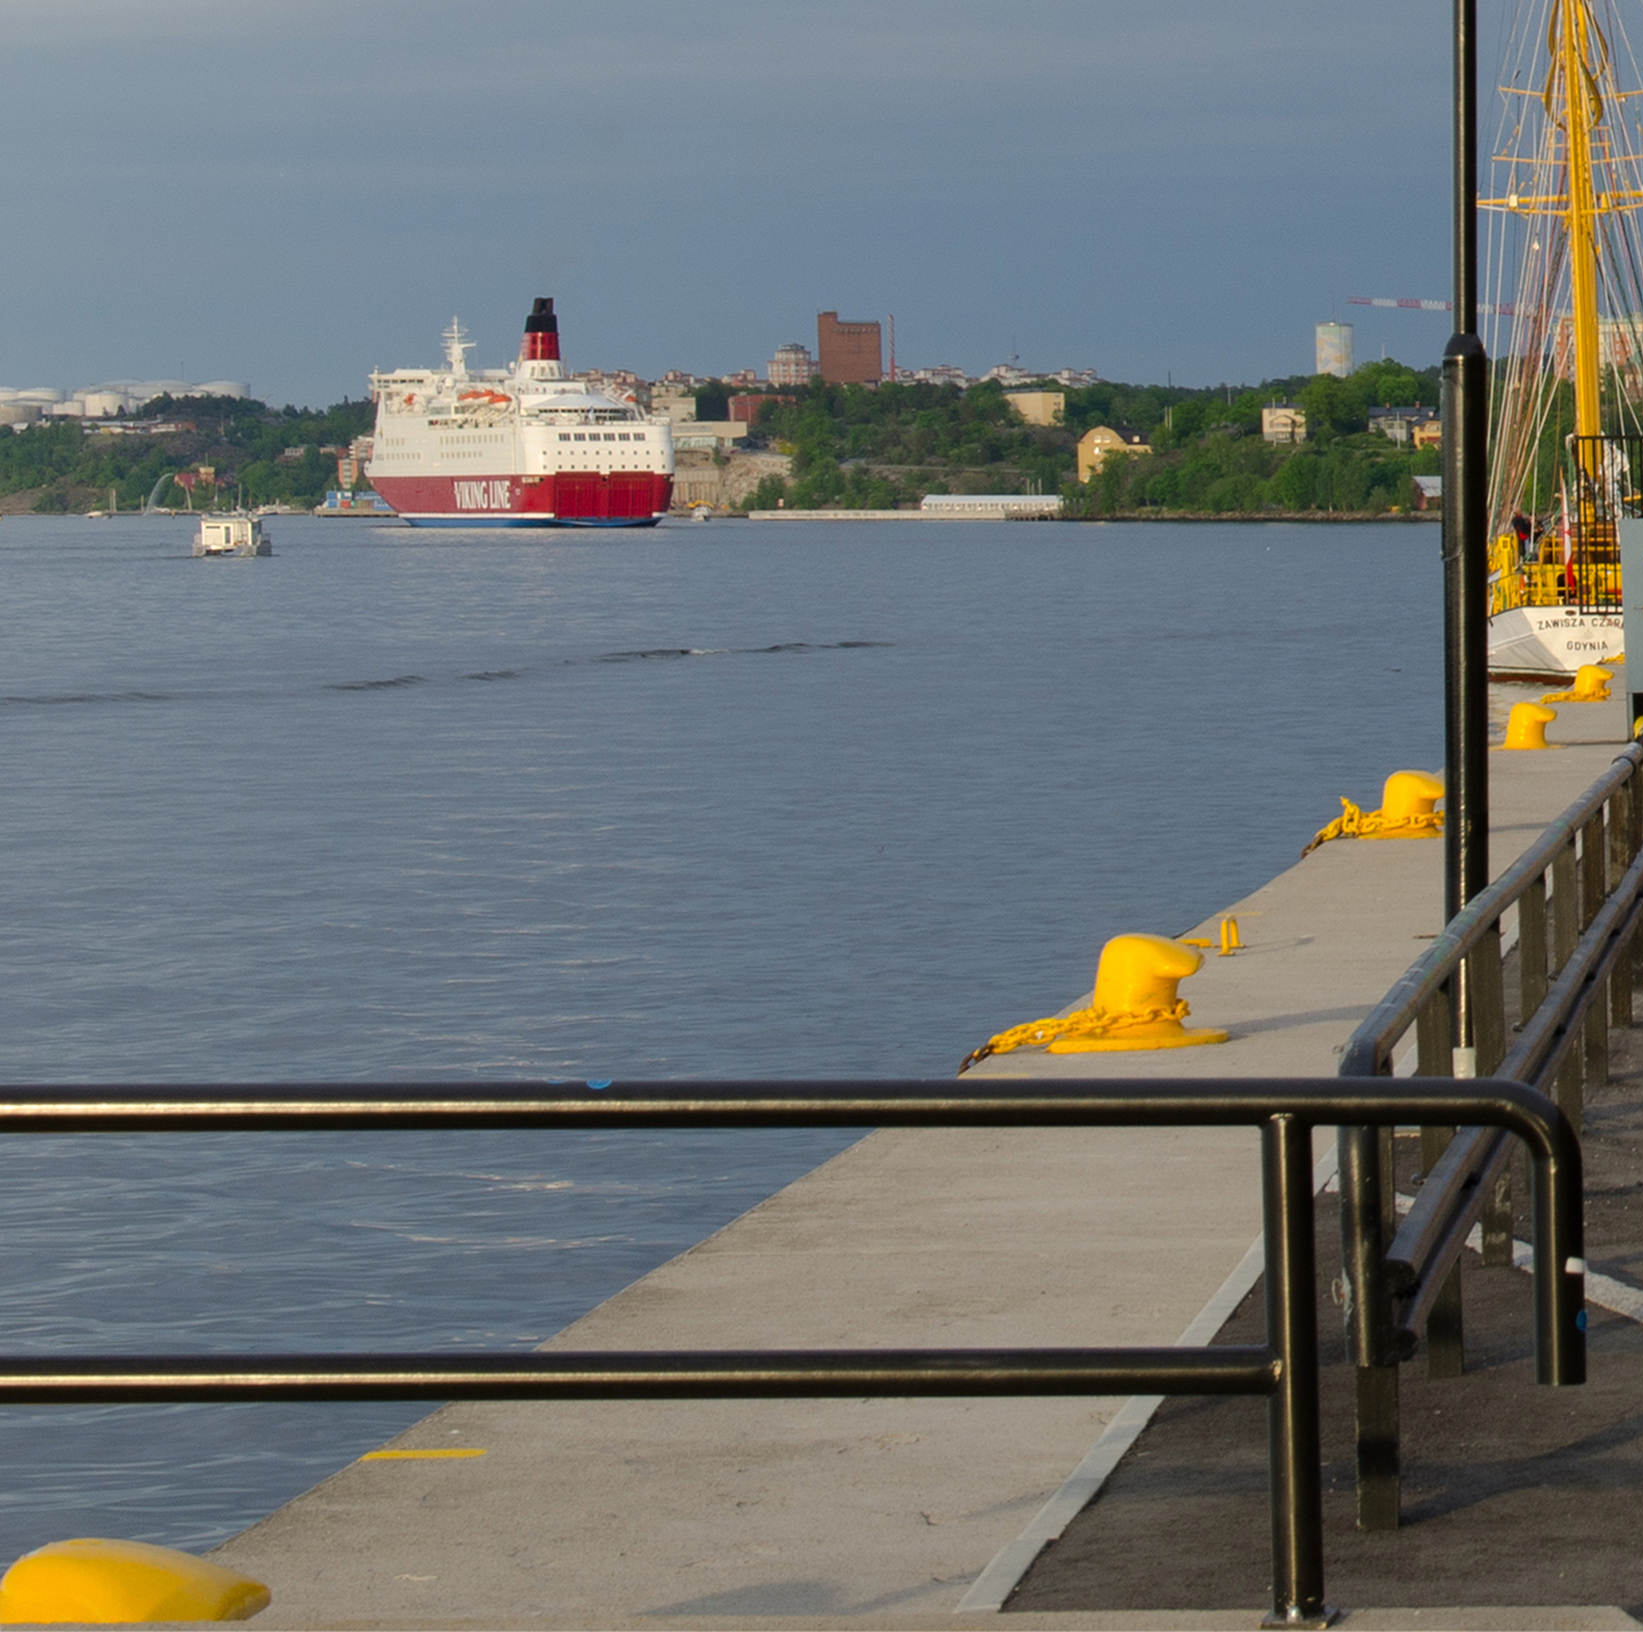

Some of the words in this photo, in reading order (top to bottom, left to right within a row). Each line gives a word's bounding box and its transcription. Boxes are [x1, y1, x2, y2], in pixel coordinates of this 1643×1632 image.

[454, 481, 488, 509] VIKING
[490, 481, 511, 509] LINE
[1538, 618, 1586, 631] ZAWISZA
[1591, 617, 1624, 630] CZAR
[1566, 640, 1609, 651] GDYNIA
